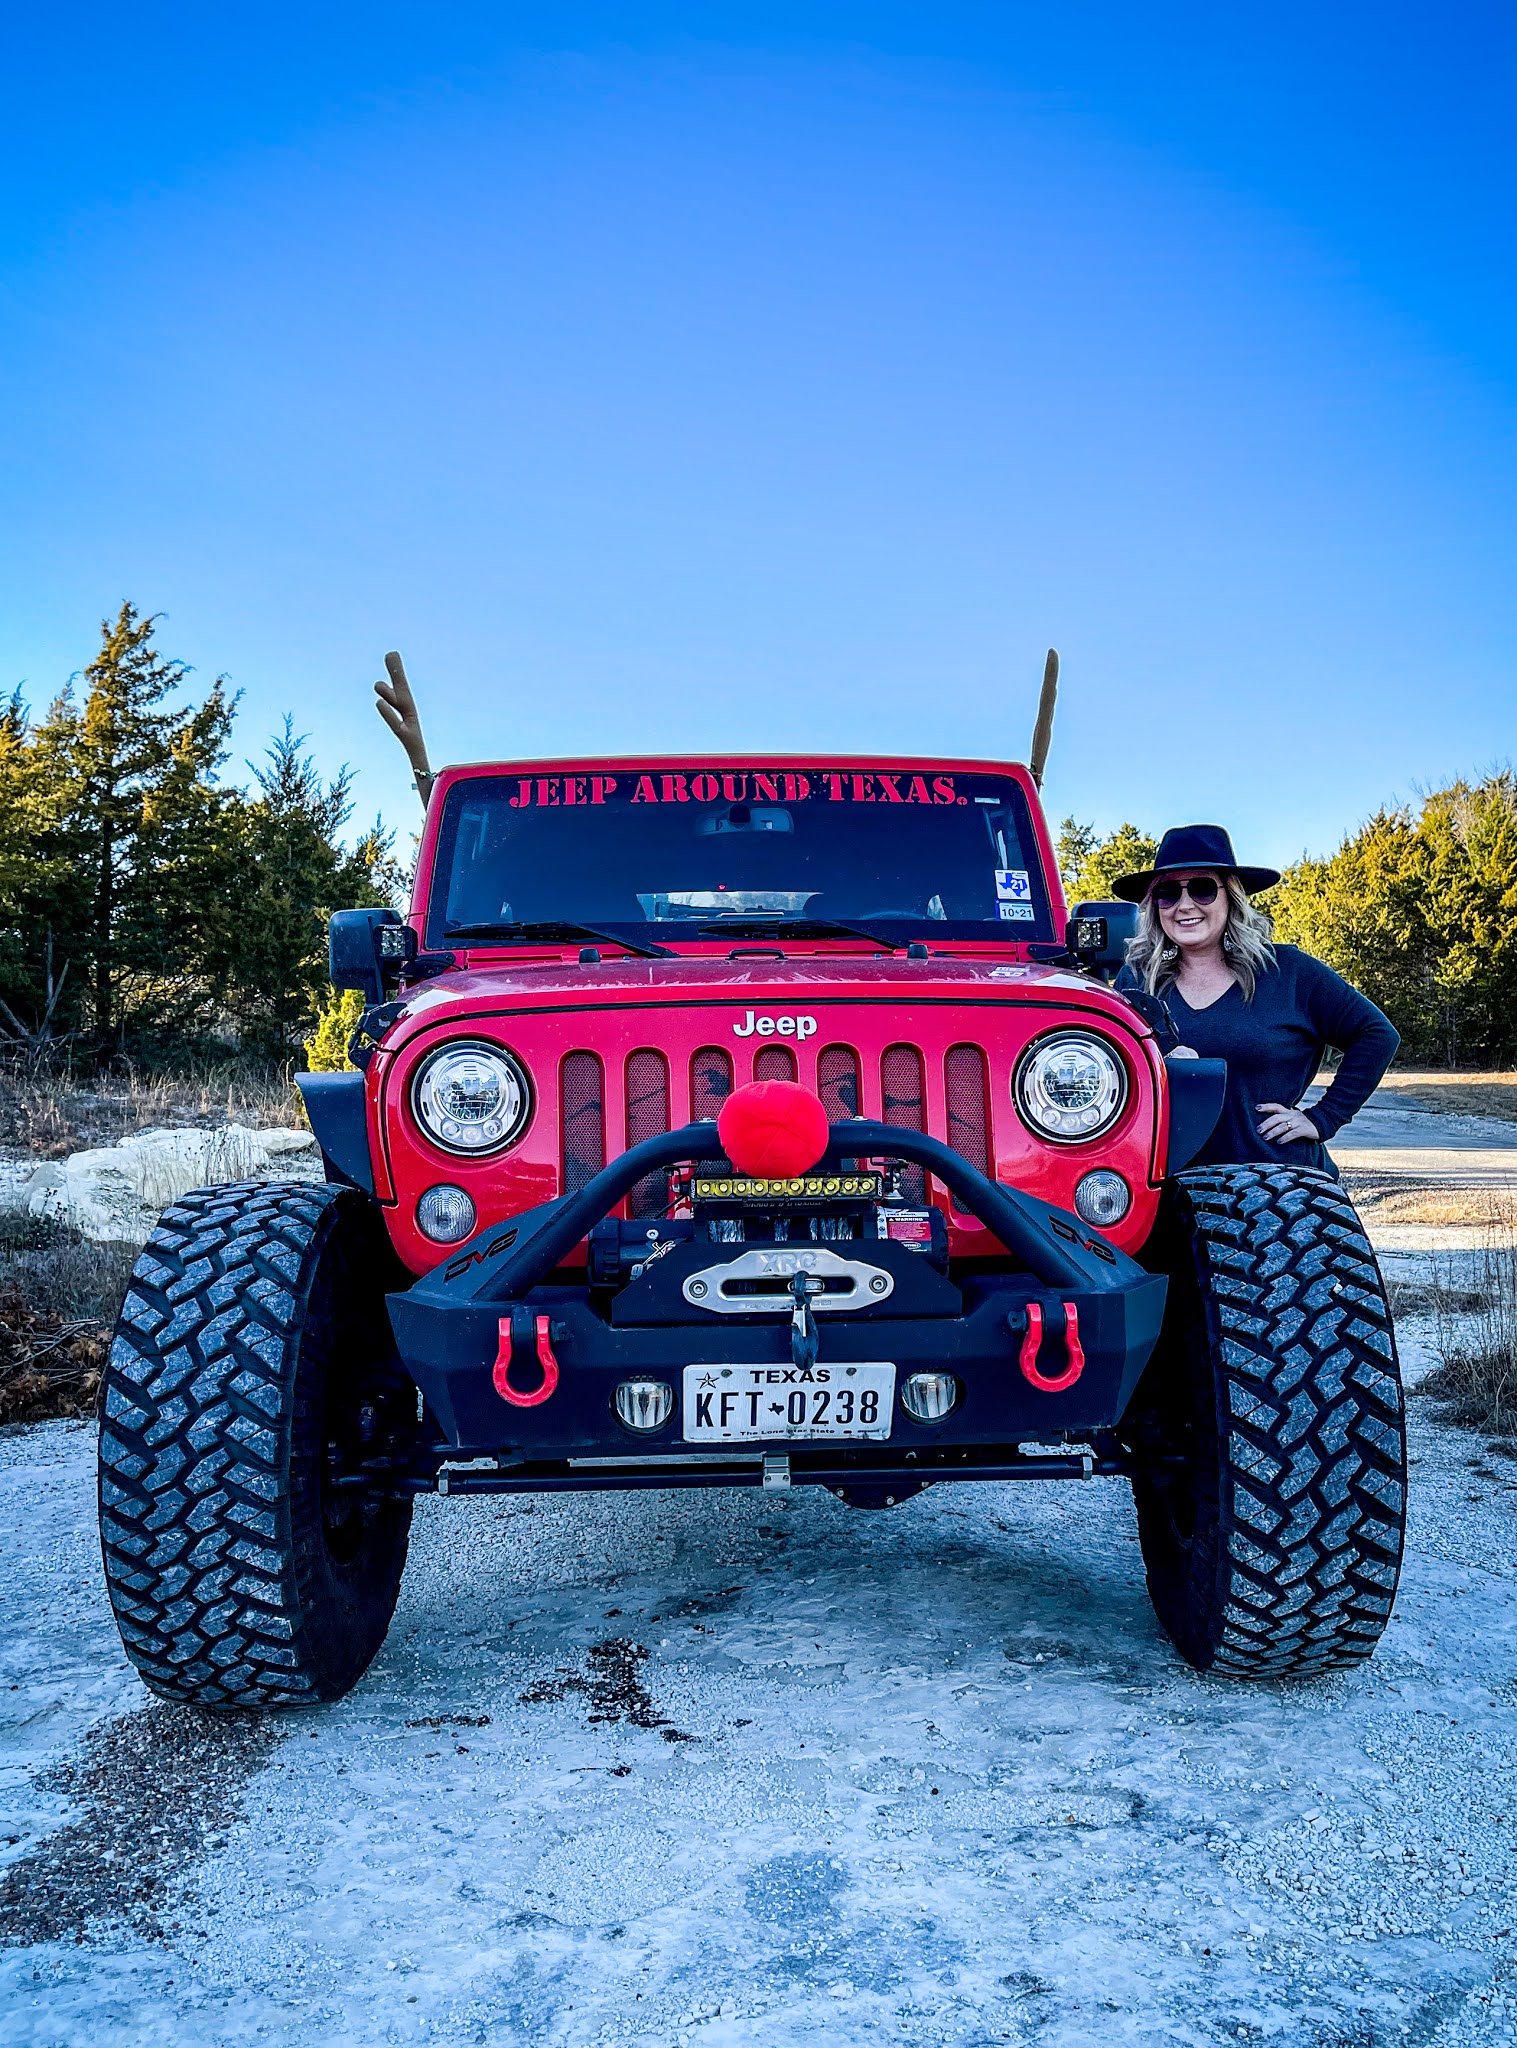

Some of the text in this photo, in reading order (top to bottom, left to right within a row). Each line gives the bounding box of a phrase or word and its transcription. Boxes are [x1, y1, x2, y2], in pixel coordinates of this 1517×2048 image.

[509, 776, 618, 809] JEEP
[630, 773, 810, 803] AROUND
[1010, 879, 1024, 890] 21
[732, 1009, 818, 1041] Jeep
[760, 1252, 817, 1273] XRC
[750, 1369, 831, 1384] TEXAS
